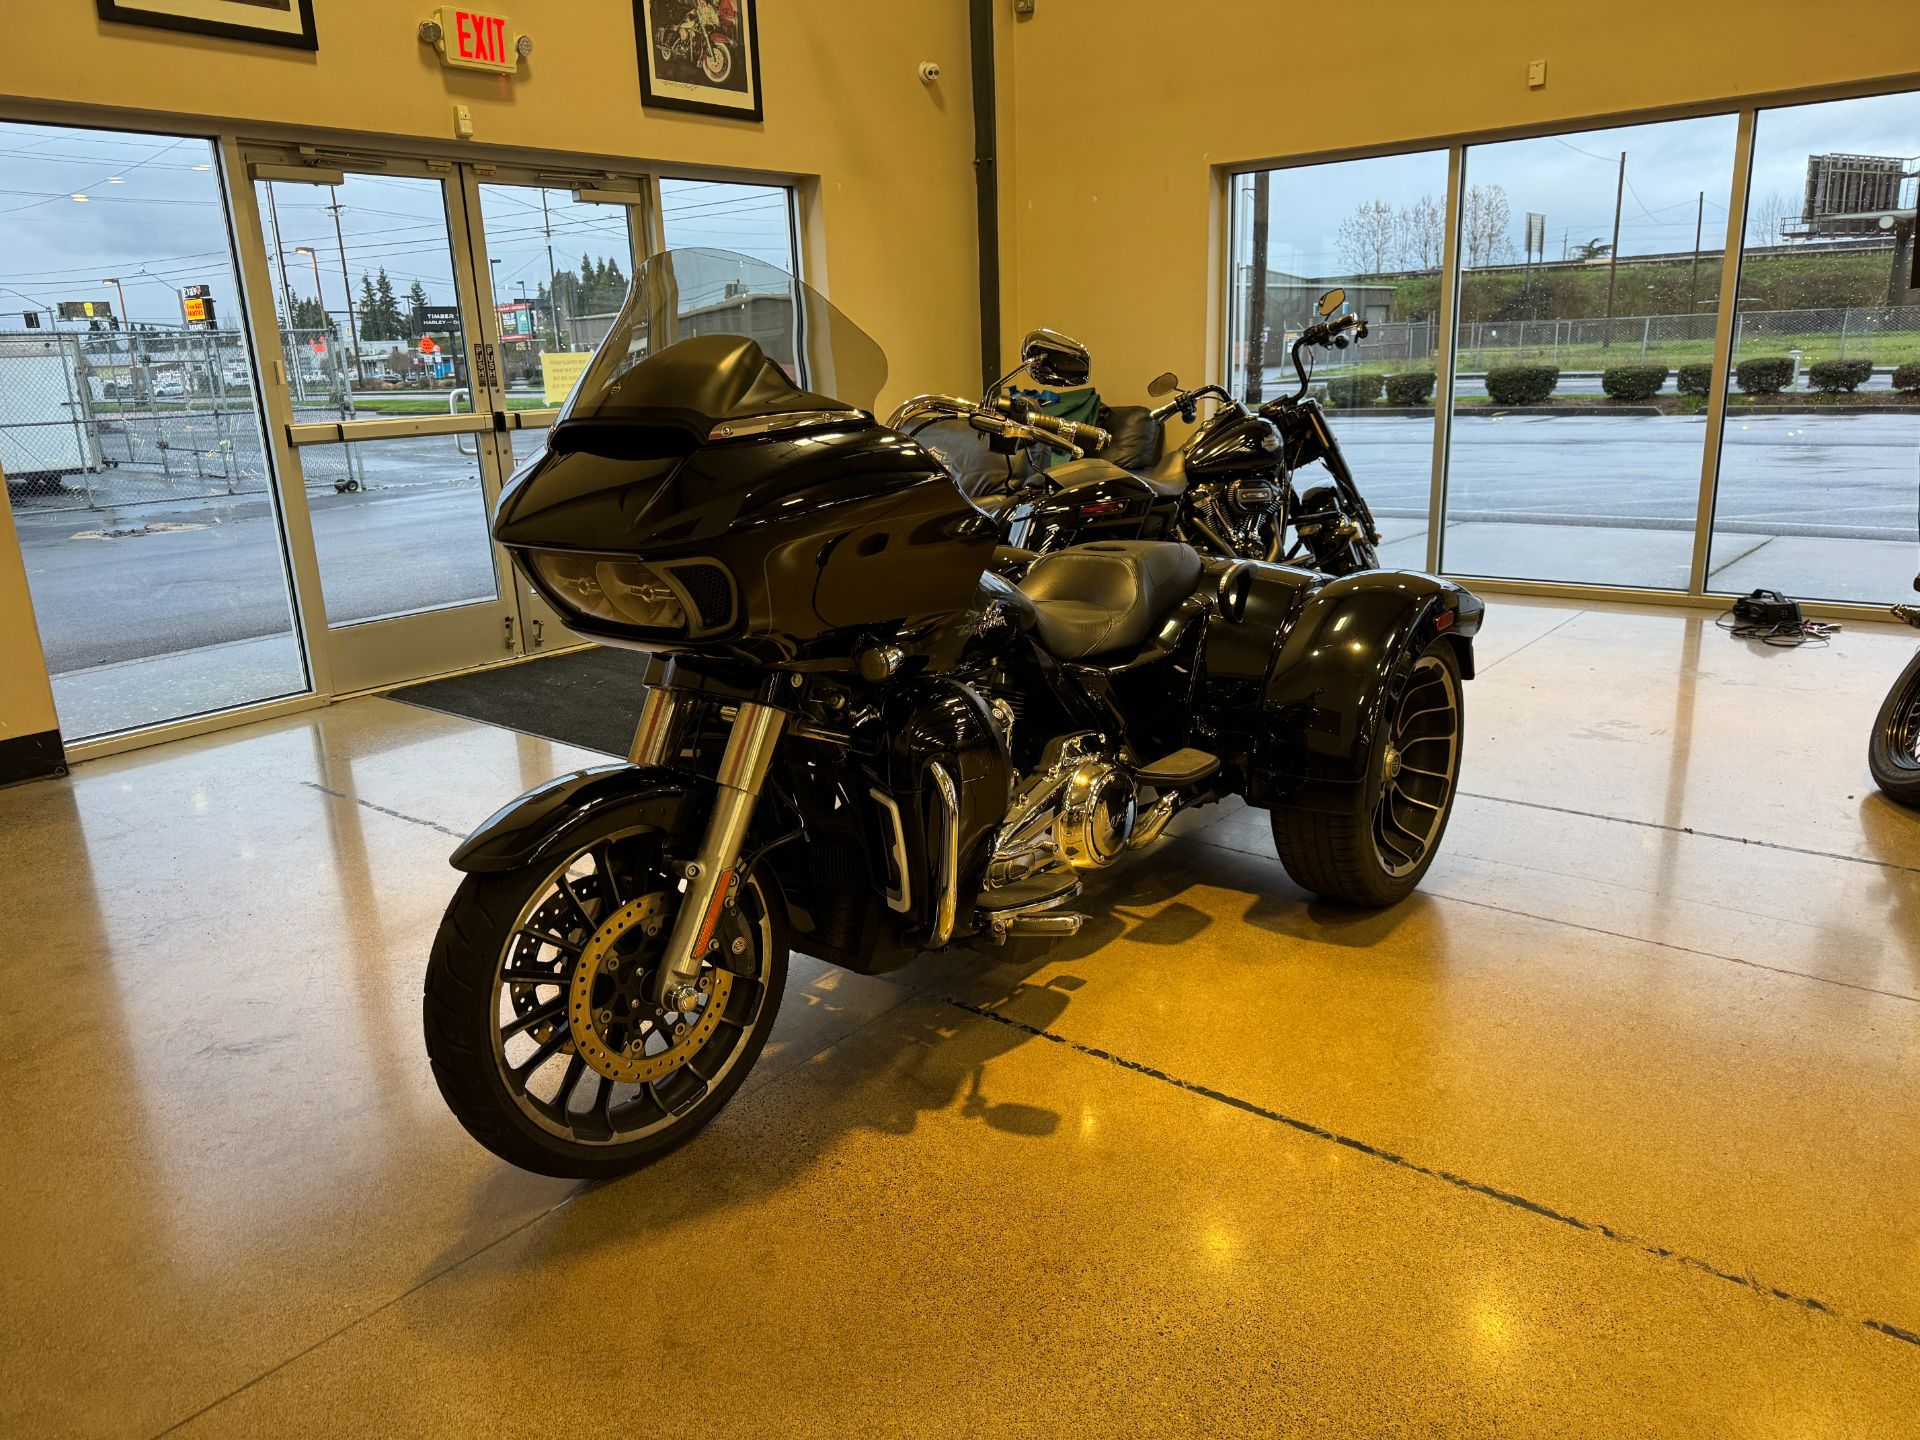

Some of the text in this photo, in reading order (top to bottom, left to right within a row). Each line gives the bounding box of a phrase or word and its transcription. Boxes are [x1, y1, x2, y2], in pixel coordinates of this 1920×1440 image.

[456, 11, 505, 64] EXIT
[476, 347, 485, 377] PUSH
[486, 347, 496, 377] PUSH
